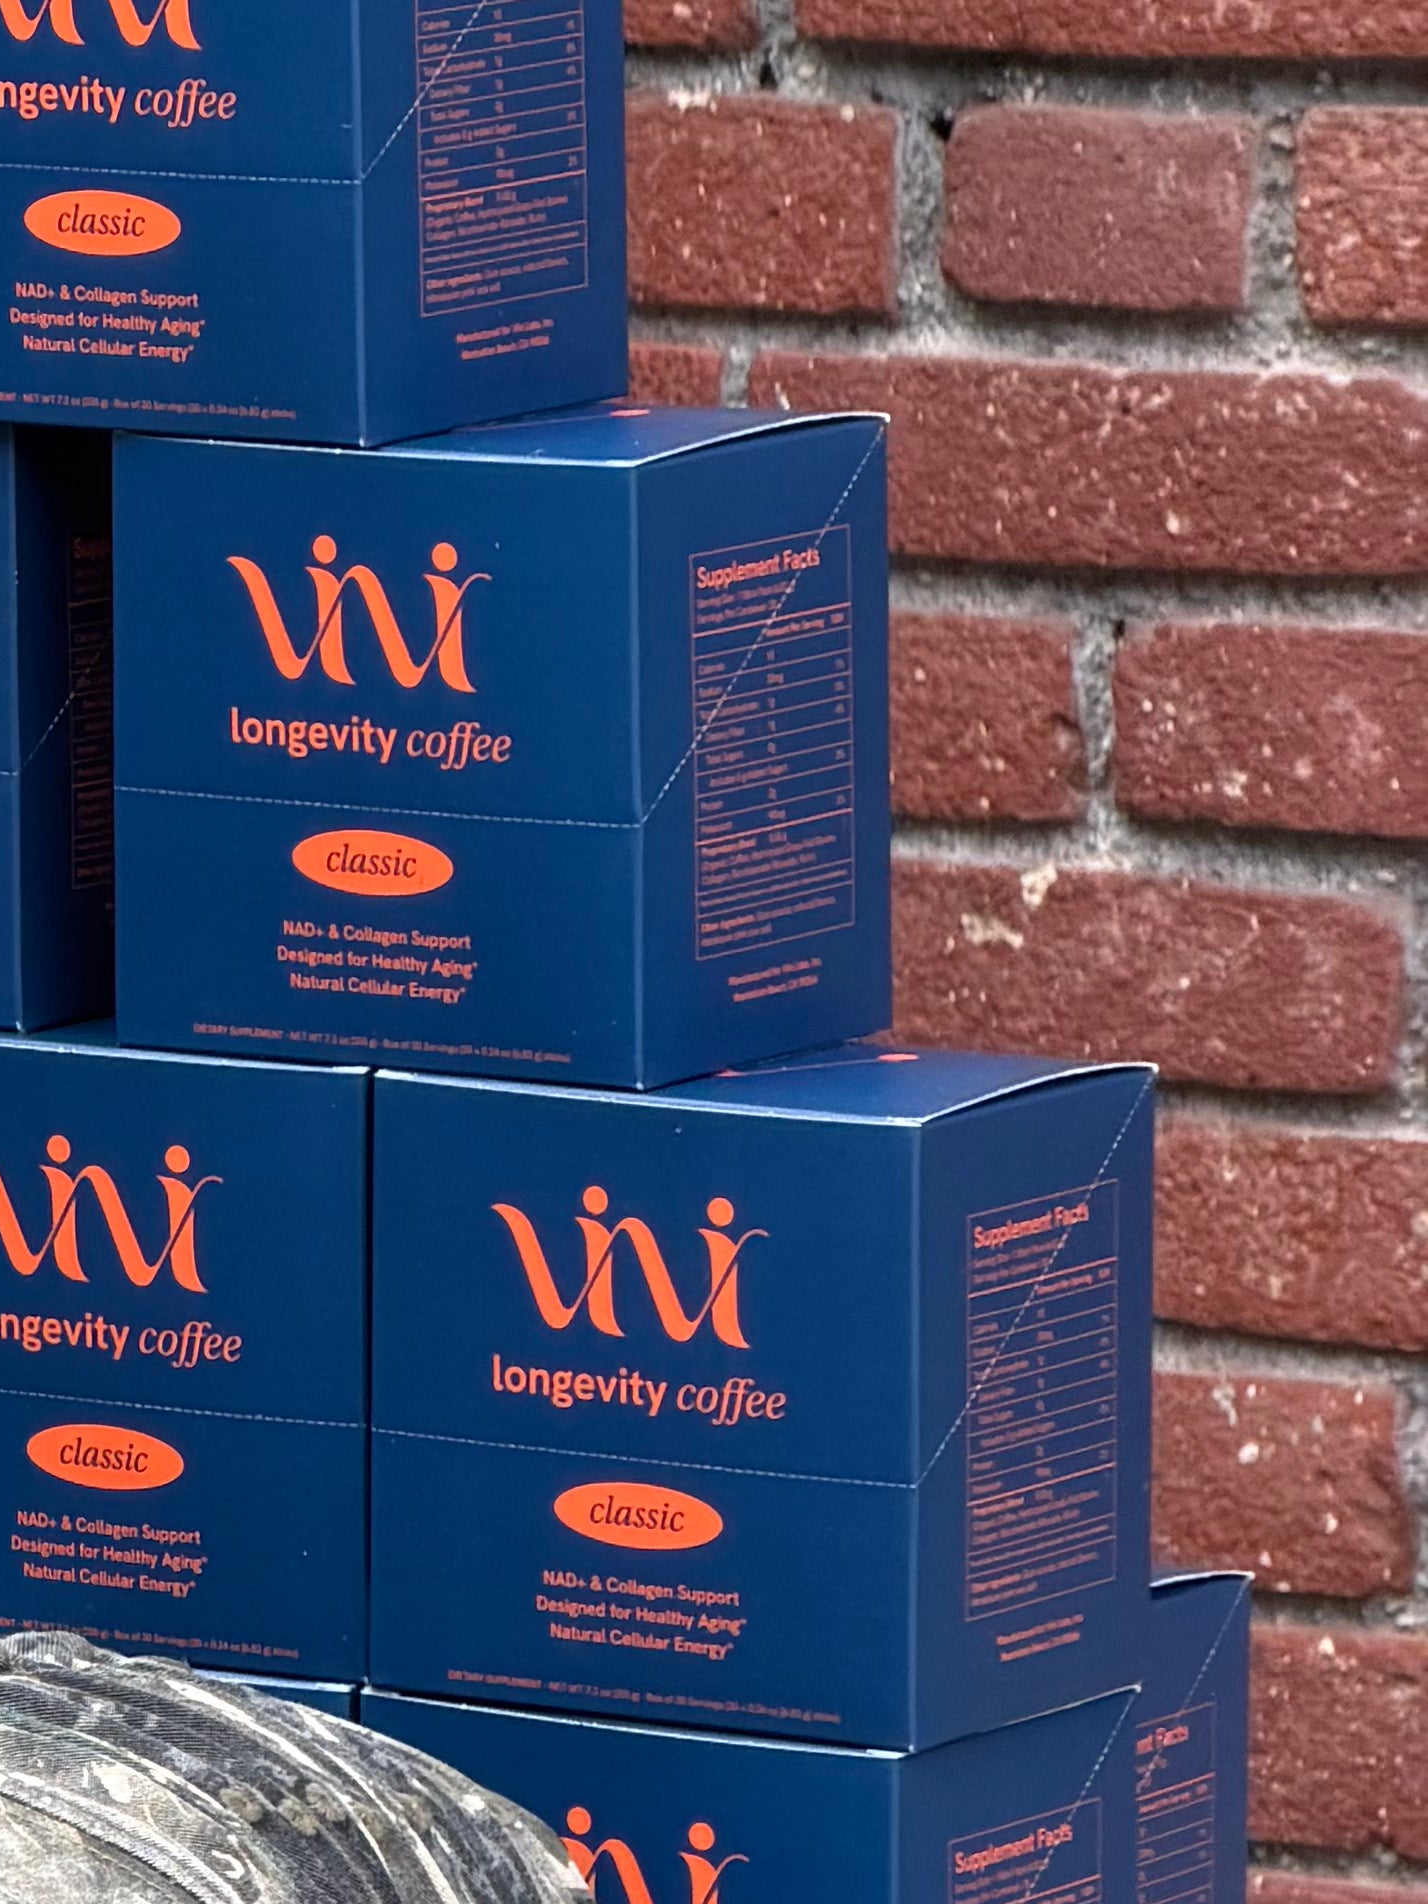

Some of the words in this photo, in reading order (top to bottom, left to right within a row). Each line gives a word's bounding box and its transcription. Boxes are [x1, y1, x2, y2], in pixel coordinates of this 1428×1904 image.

[132, 79, 237, 129] coffee
[57, 203, 146, 237] classic
[14, 282, 55, 300] NAD+
[59, 285, 71, 301] &
[73, 285, 137, 308] Collagen
[139, 289, 198, 310] Support
[9, 307, 75, 330] Designed
[76, 312, 99, 329] for
[101, 314, 157, 335] Healthy
[22, 336, 75, 353] Natural
[77, 338, 134, 356] Cellular
[697, 554, 780, 590] Supplement
[782, 547, 820, 571] Facts
[229, 707, 397, 765] longevity
[404, 721, 512, 772] coffee
[326, 843, 417, 878] classic
[974, 1211, 1052, 1249] Supplement
[1054, 1202, 1089, 1226] Facts
[137, 1321, 242, 1369] coffee
[491, 1354, 668, 1417] longevity
[675, 1377, 787, 1427] coffee
[60, 1437, 148, 1473] classic
[589, 1495, 685, 1532] classic
